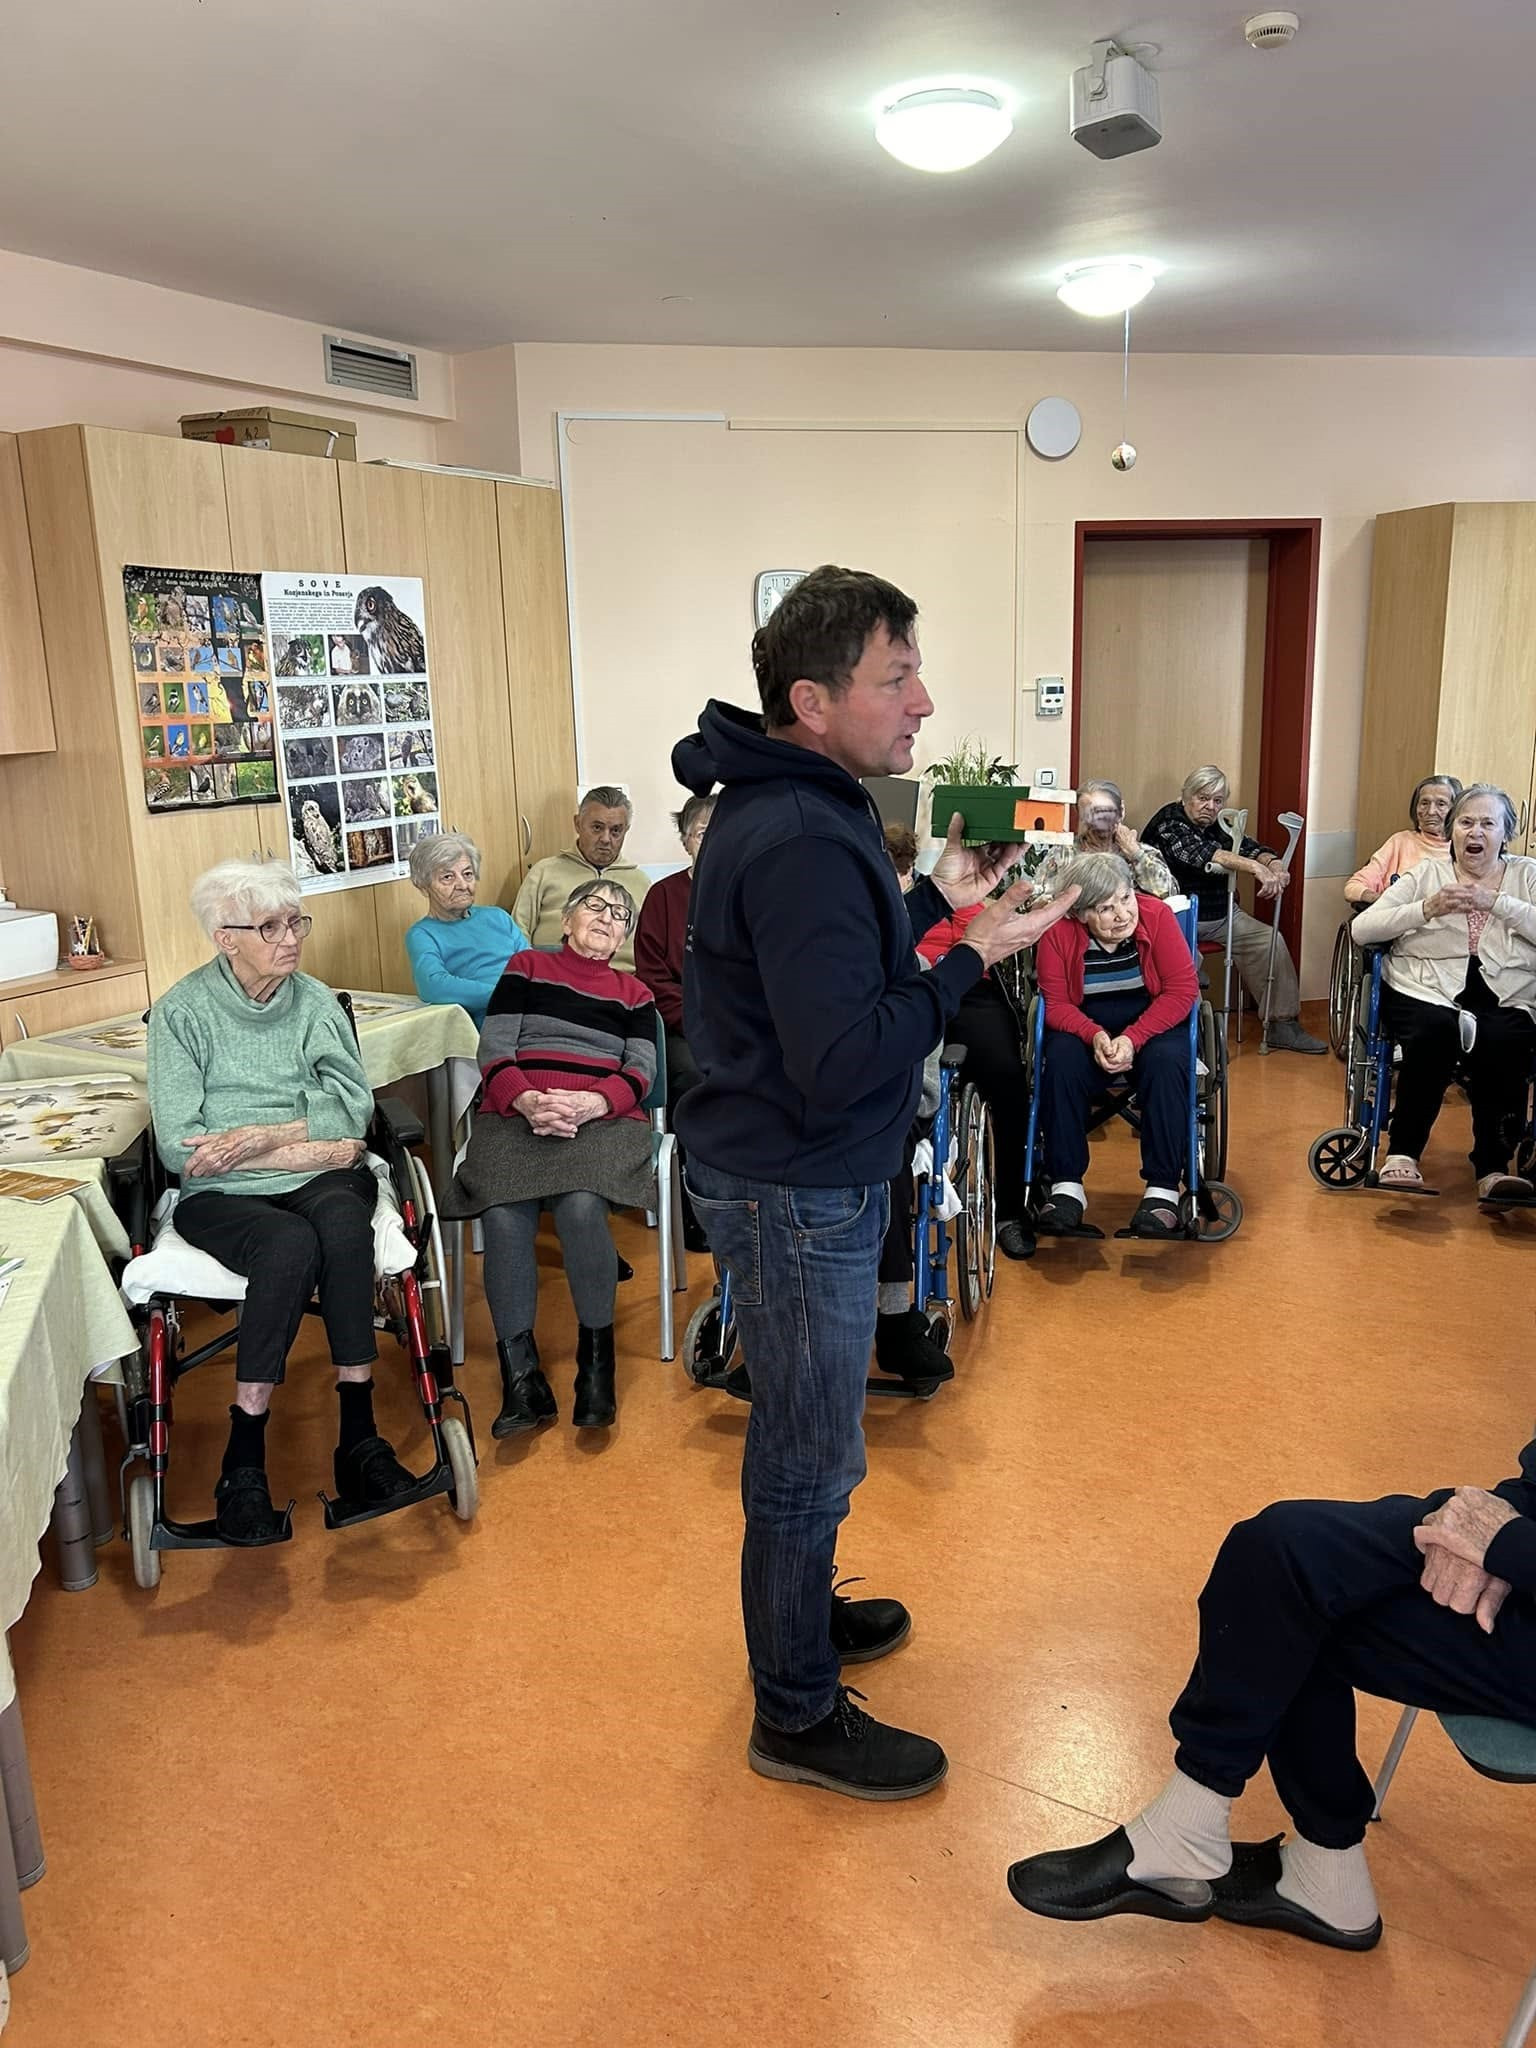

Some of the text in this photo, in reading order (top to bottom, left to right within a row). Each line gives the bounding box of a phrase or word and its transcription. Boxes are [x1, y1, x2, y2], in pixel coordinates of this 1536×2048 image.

[771, 578, 778, 587] 11
[783, 577, 790, 587] 12
[764, 586, 771, 596] 10
[763, 598, 769, 607] 9
